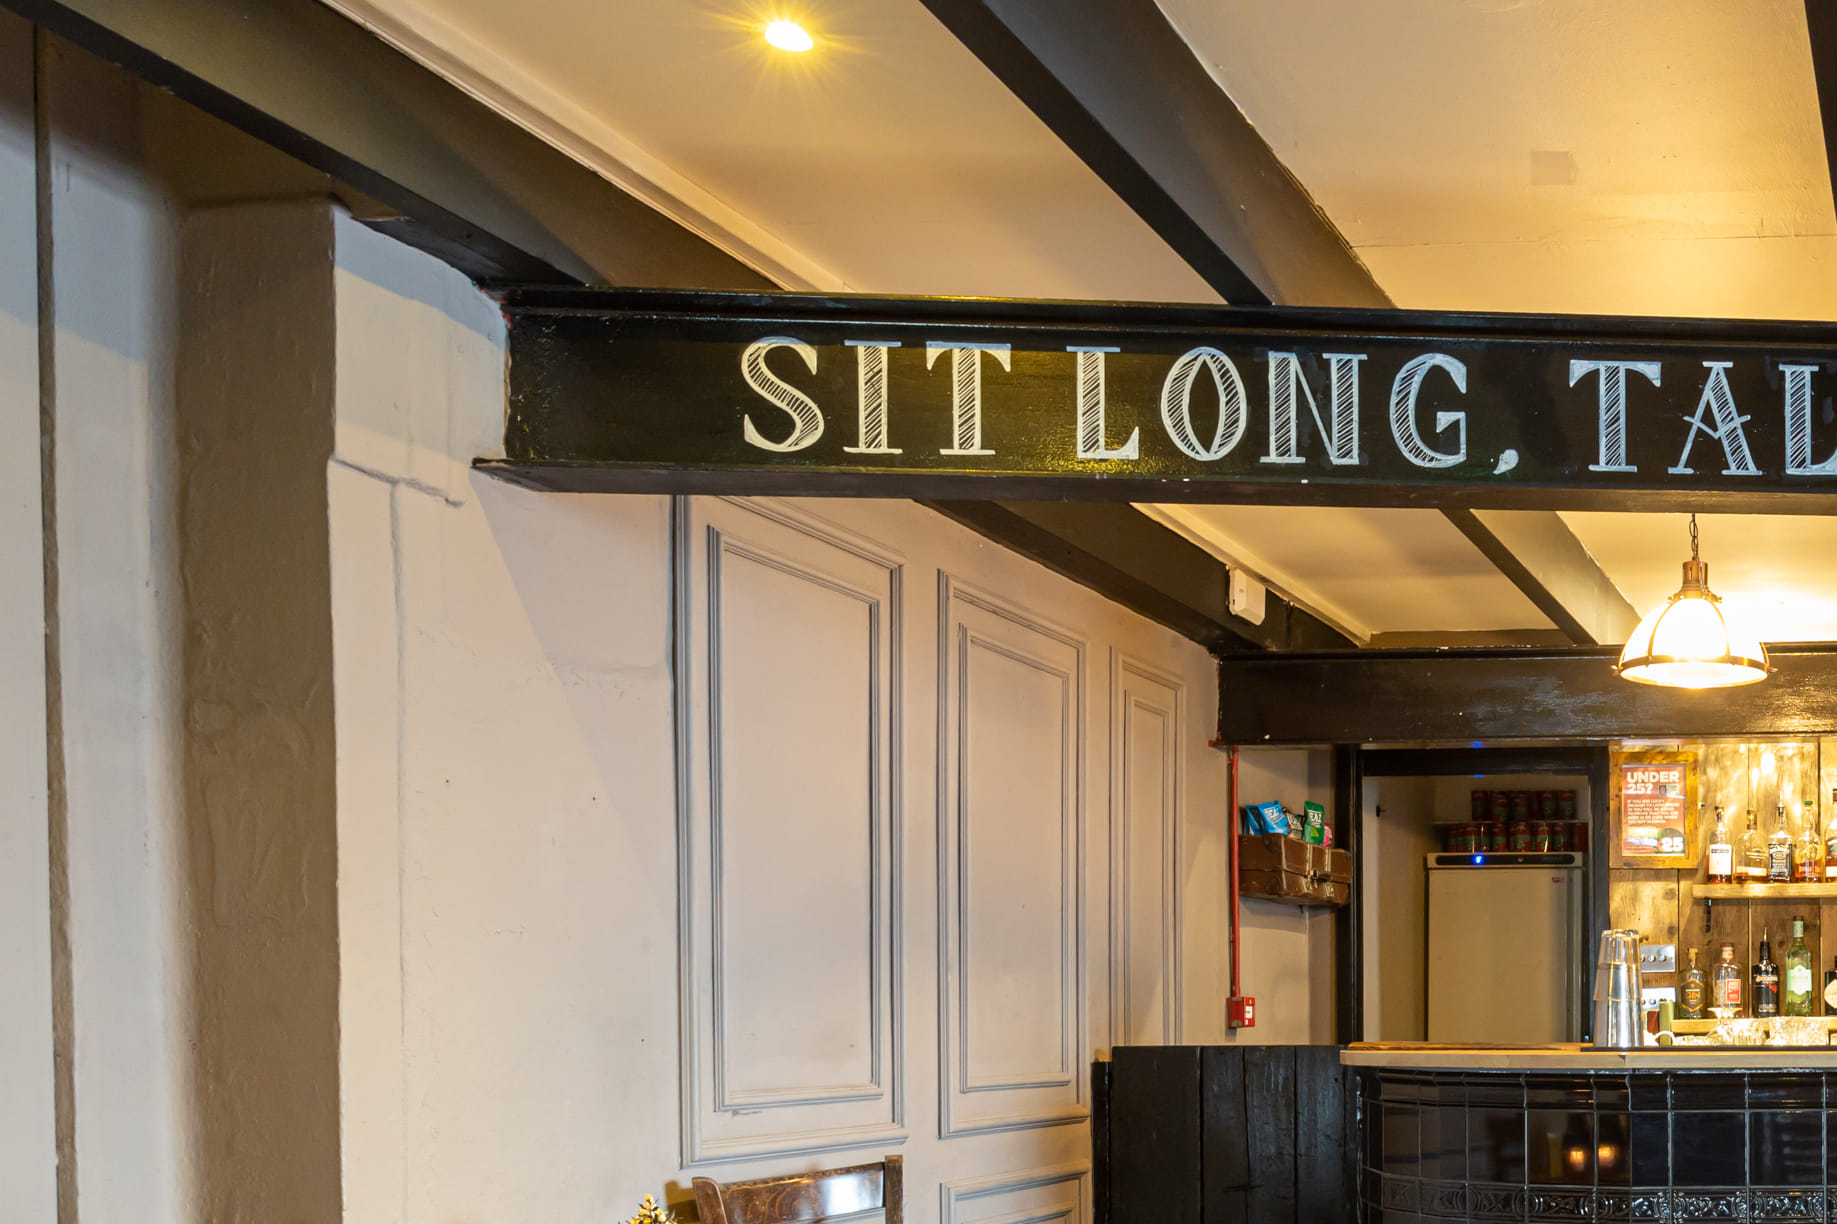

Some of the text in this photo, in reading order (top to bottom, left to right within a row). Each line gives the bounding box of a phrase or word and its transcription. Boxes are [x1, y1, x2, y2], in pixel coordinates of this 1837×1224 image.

[740, 337, 1012, 457] SIT
[1066, 345, 1520, 477] LONG,
[1627, 771, 1679, 782] UNDER
[1627, 783, 1653, 794] 25?
